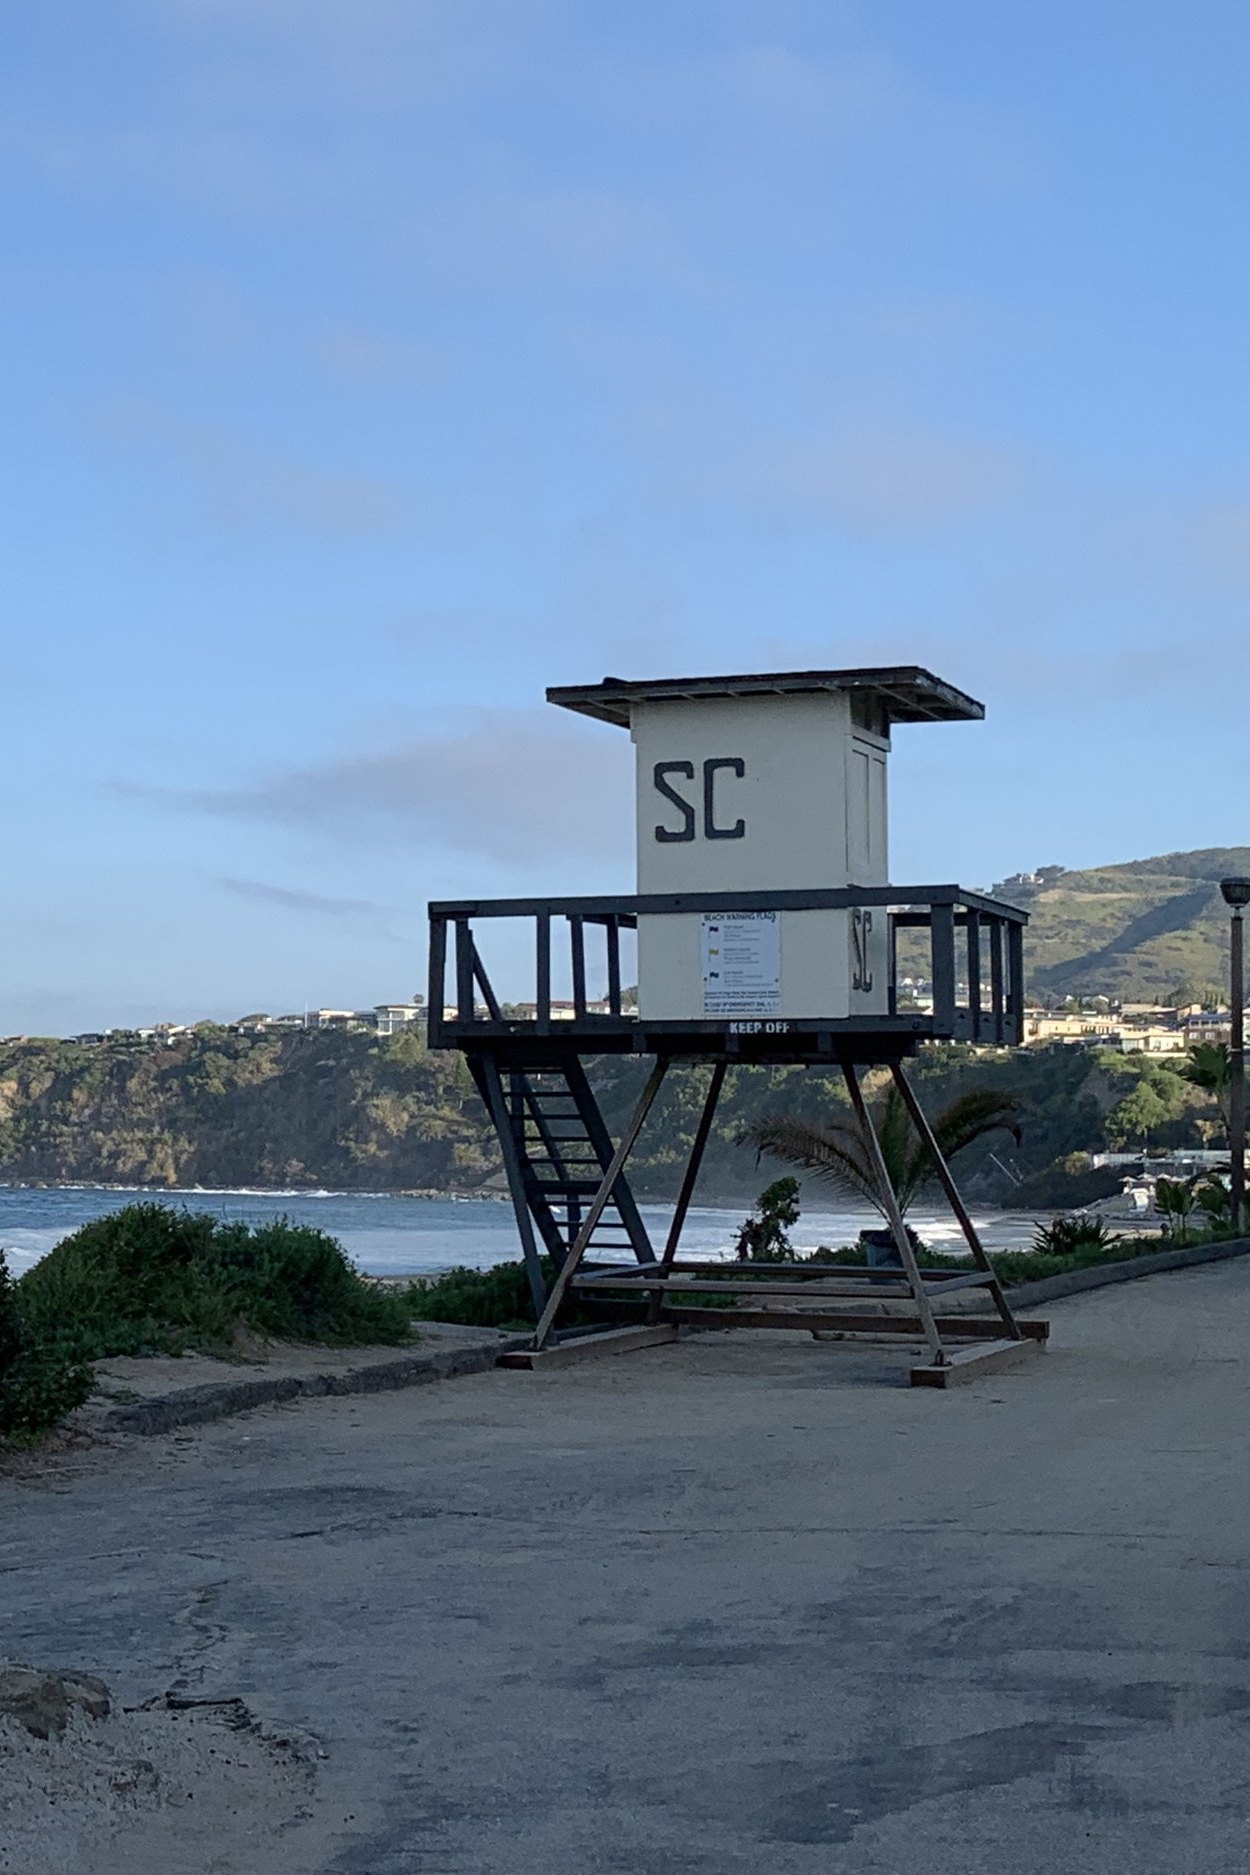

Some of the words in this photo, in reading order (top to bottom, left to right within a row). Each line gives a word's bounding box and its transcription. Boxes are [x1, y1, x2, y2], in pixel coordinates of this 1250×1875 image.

[654, 757, 745, 843] SC
[704, 913, 725, 922] BEACH
[726, 912, 755, 921] WARNING
[756, 911, 776, 920] FLAGS
[730, 1022, 762, 1034] KEEP
[765, 1022, 790, 1033] OFF
